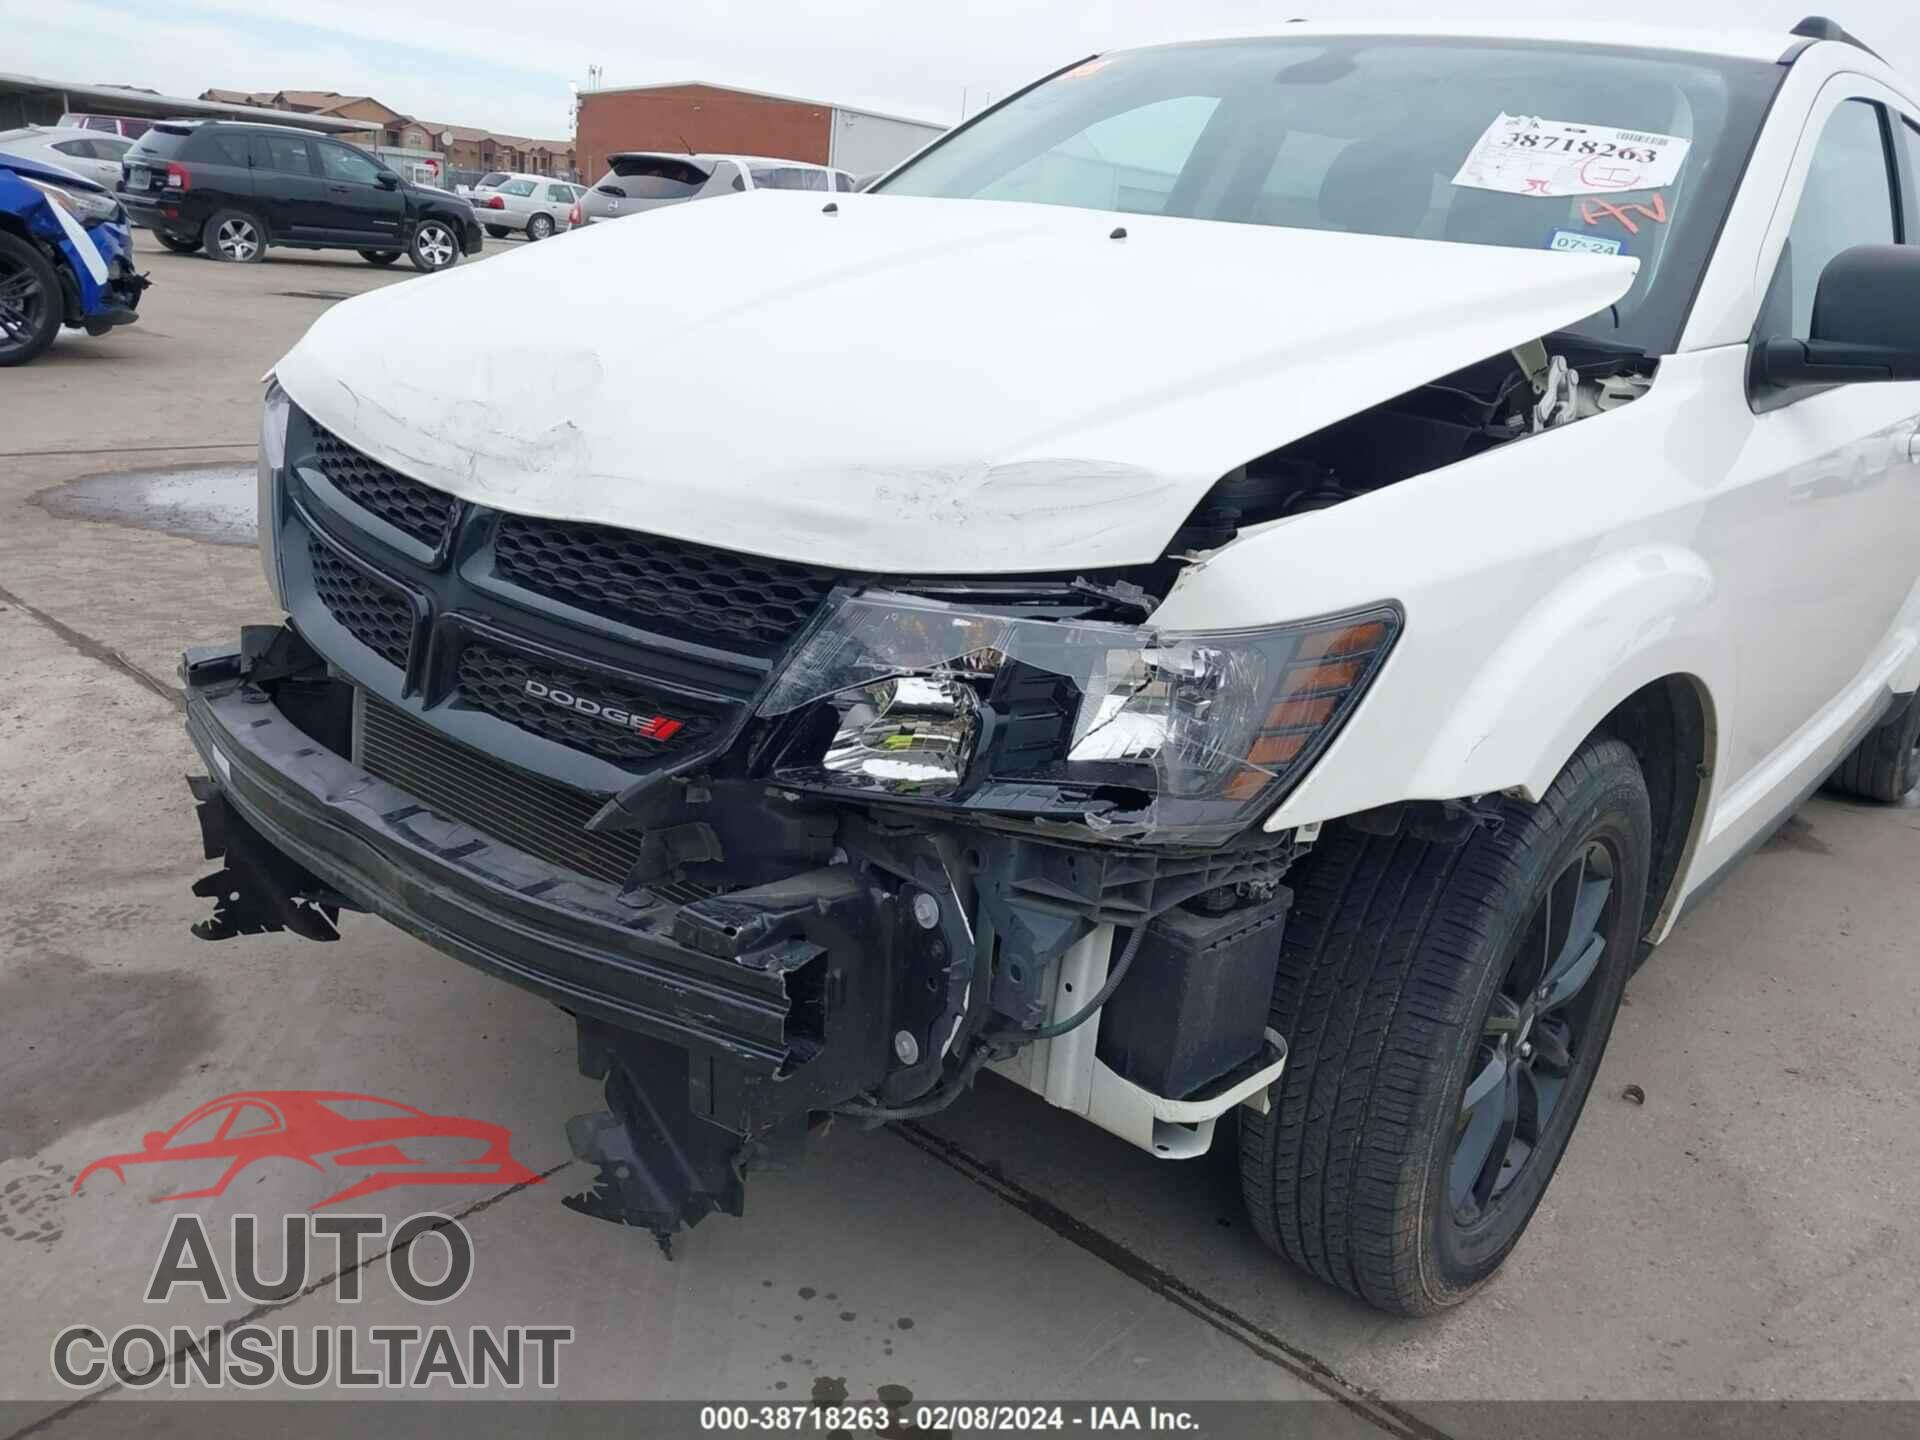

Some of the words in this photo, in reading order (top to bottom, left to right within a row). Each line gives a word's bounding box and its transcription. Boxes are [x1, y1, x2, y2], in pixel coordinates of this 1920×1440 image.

[1502, 132, 1657, 163] 38718263
[1557, 238, 1581, 249] 07
[1589, 243, 1615, 255] 24
[525, 679, 657, 732] DODGE
